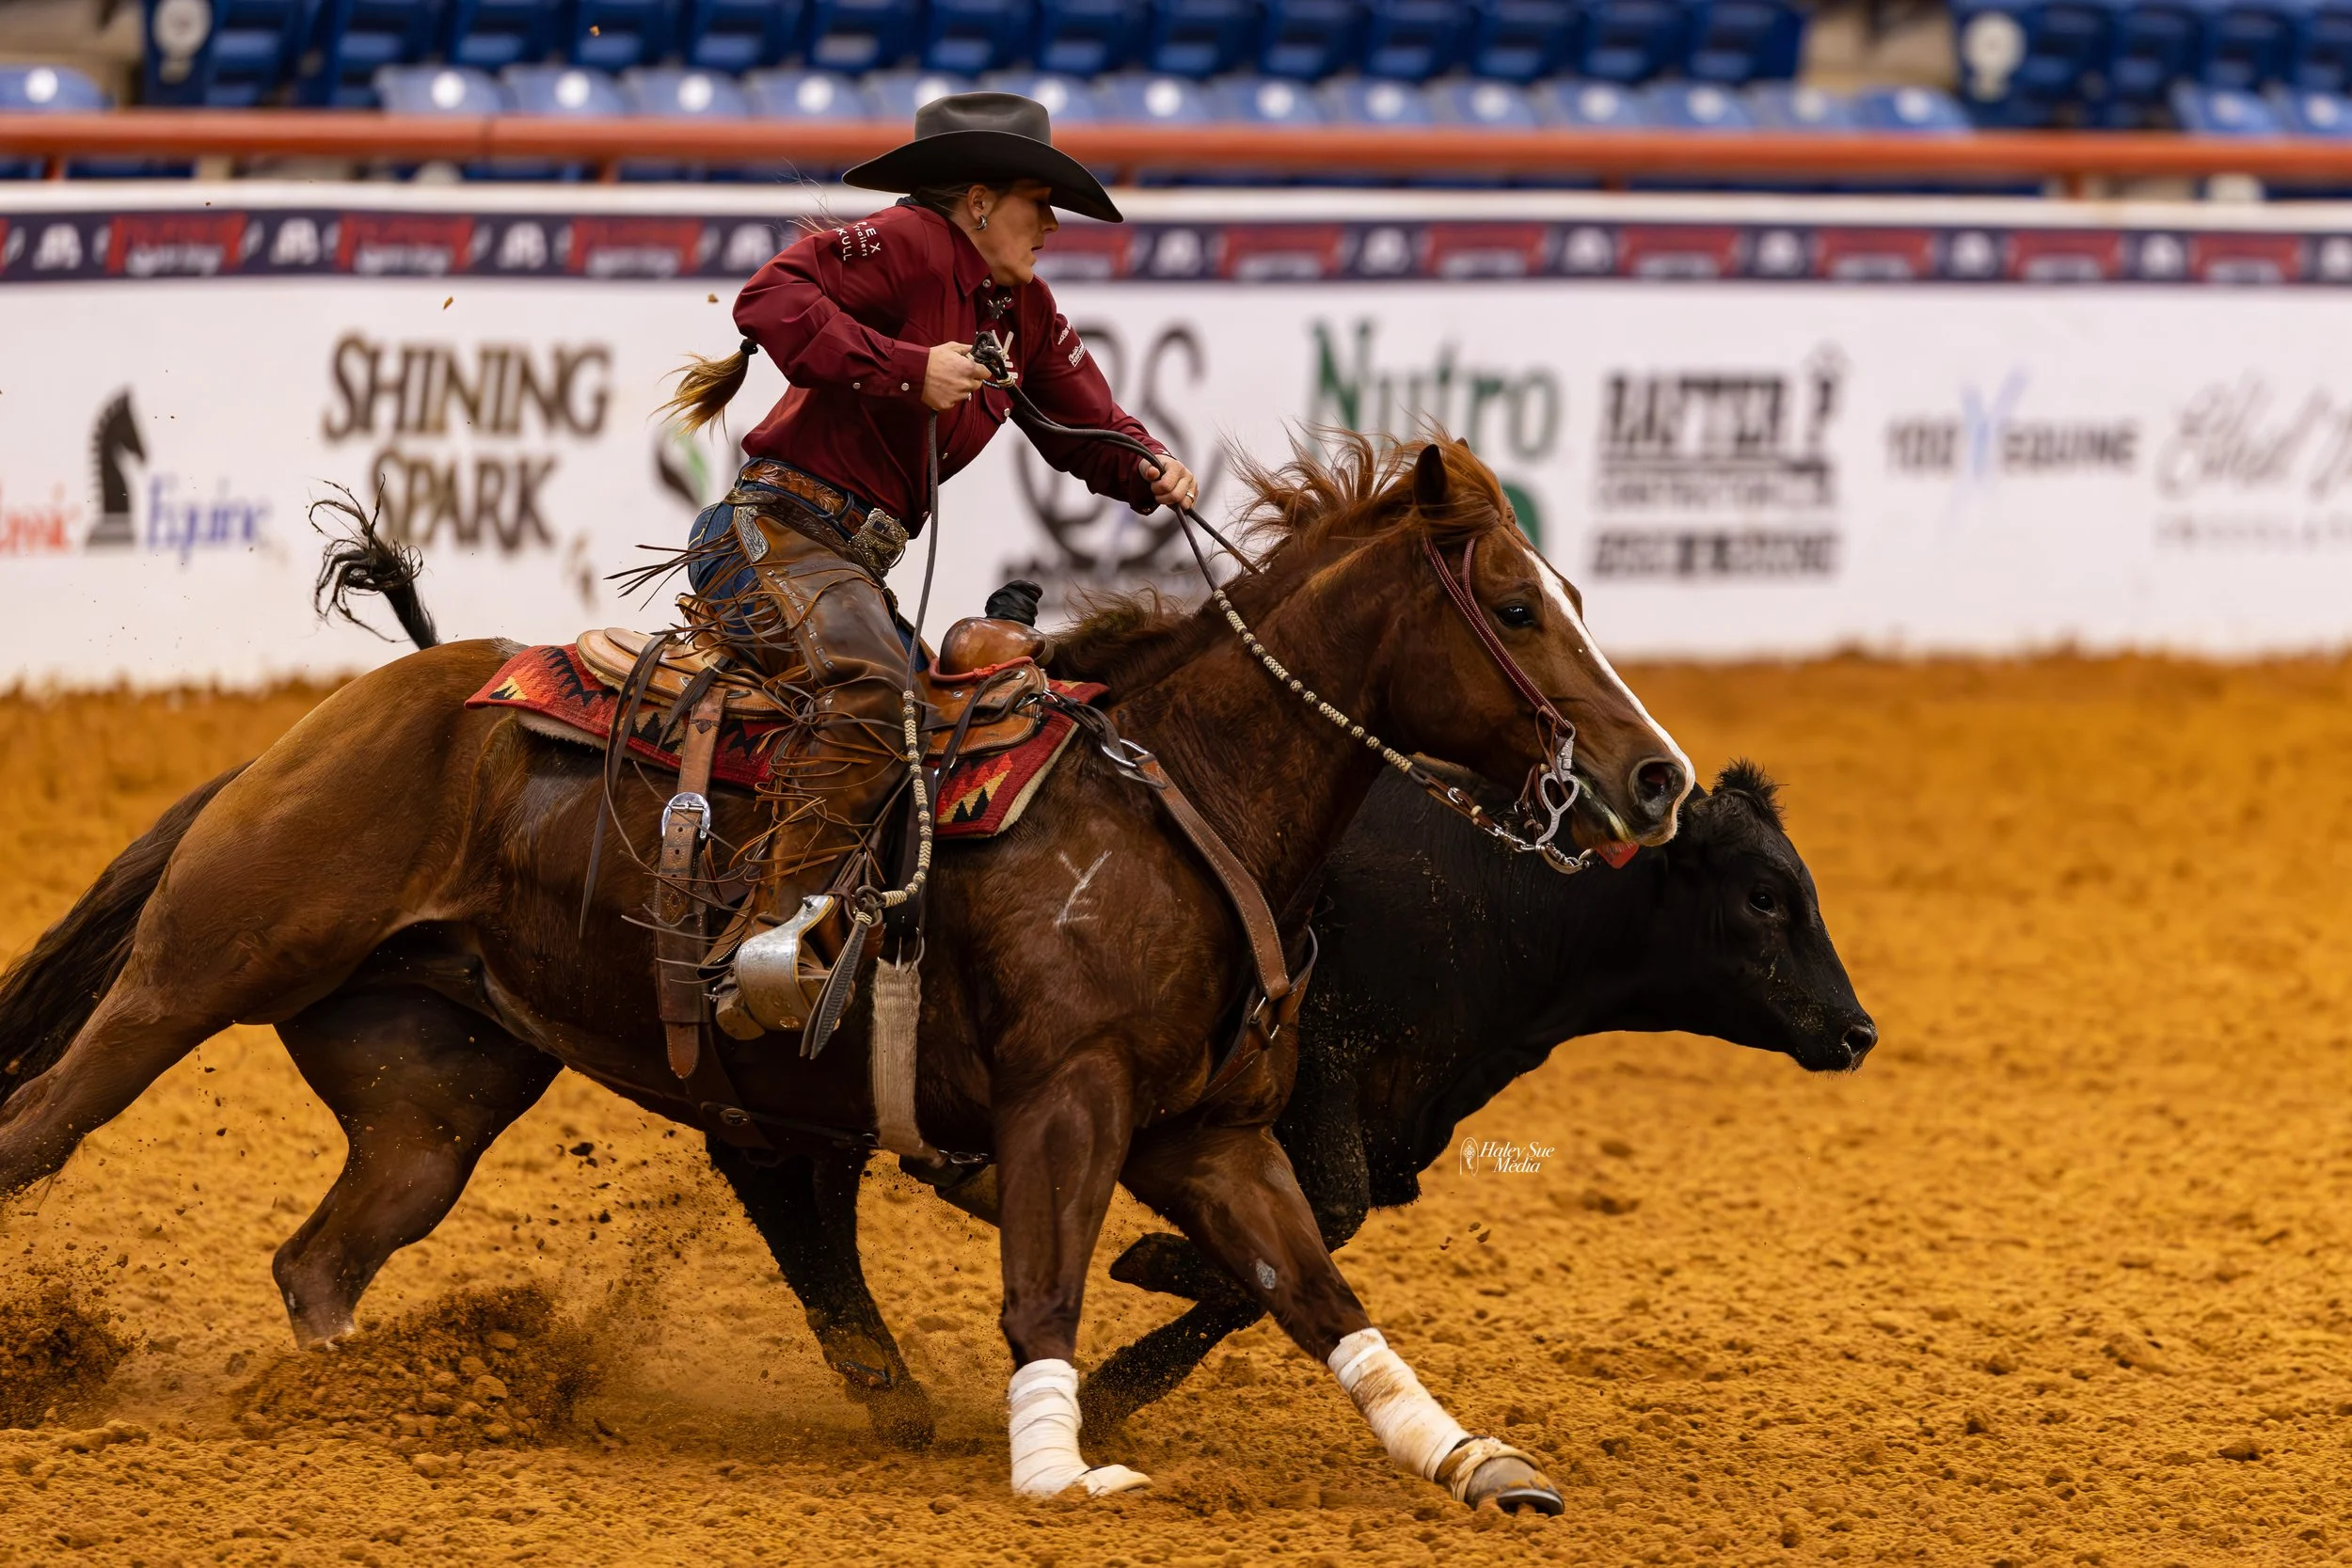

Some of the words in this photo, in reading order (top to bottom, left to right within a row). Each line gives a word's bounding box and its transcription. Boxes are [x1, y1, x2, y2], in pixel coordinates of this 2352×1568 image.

[833, 227, 853, 261] KULL
[322, 331, 613, 444] SHINING
[372, 449, 557, 550] SPARK
